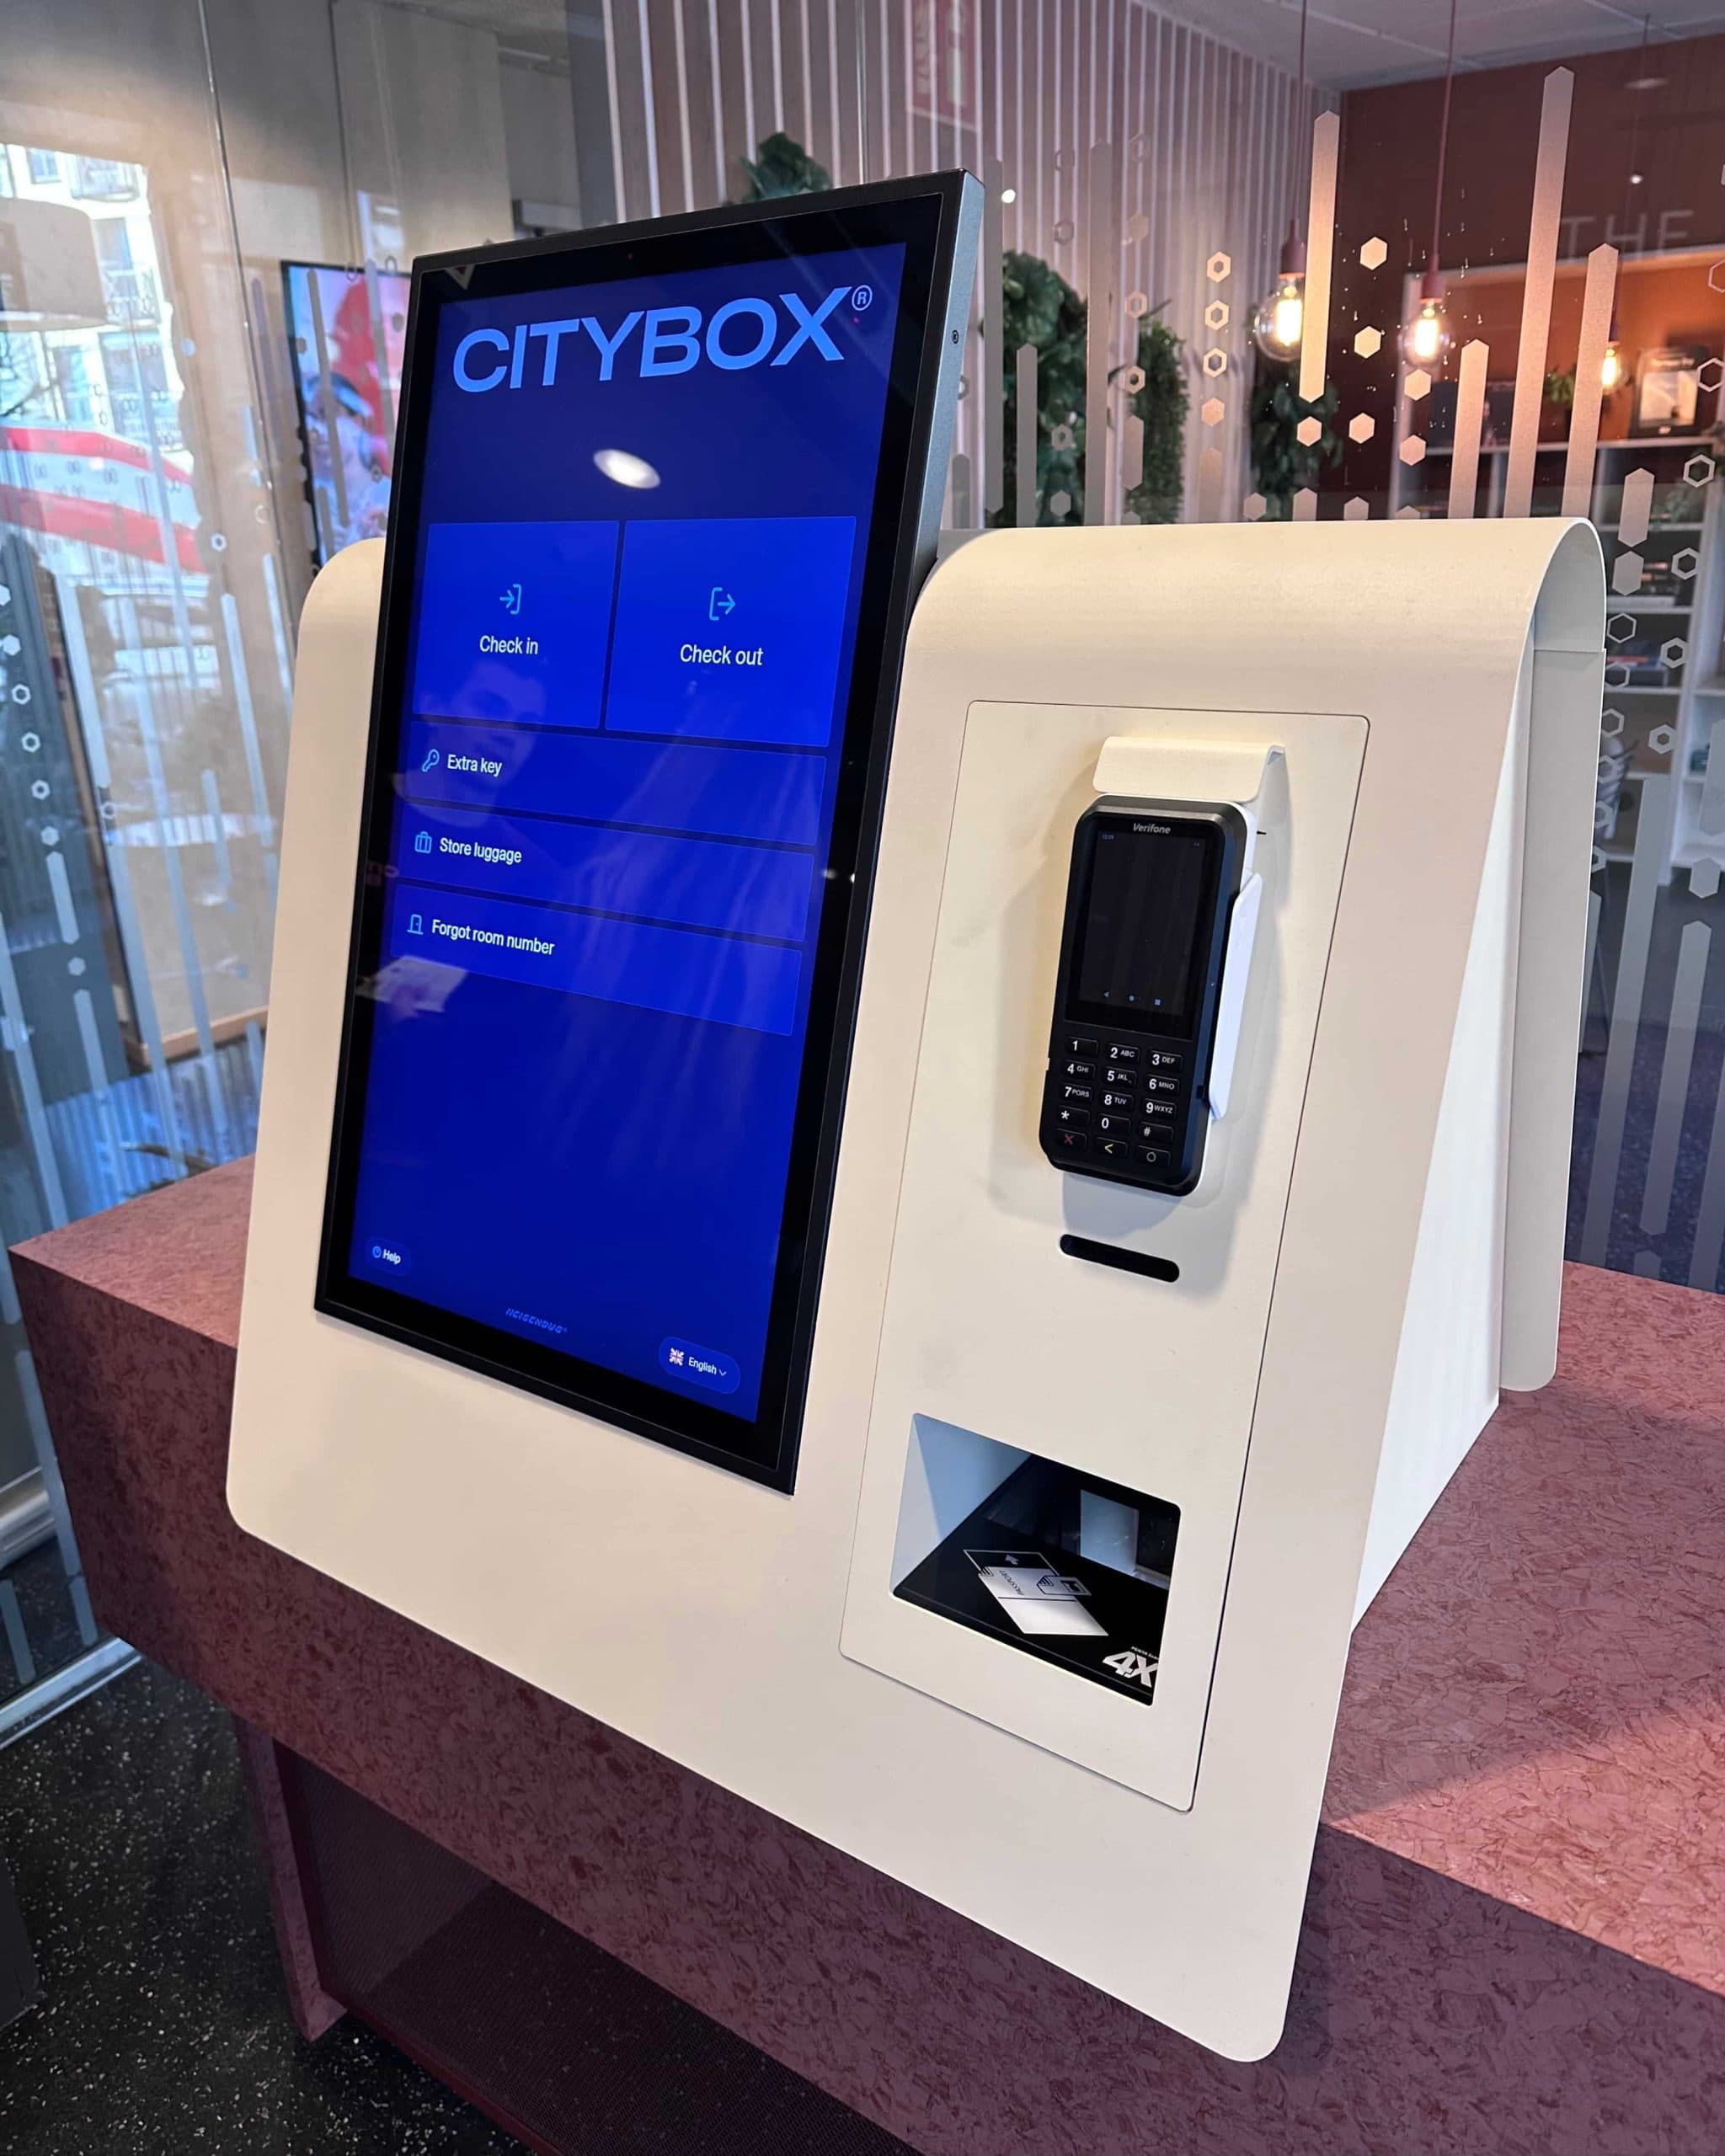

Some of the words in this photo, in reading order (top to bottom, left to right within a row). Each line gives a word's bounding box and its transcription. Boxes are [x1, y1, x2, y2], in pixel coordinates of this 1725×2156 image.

[479, 635, 523, 654] Check
[526, 637, 539, 655] in
[680, 643, 731, 664] Check
[735, 647, 764, 665] out
[447, 754, 478, 772] Extra
[480, 757, 502, 777] key
[1133, 823, 1171, 834] Verifone
[439, 837, 472, 856] Store
[473, 841, 522, 865] luggage
[431, 919, 470, 941] Forgot
[473, 927, 505, 947] room
[506, 934, 555, 955] number
[1072, 1040, 1078, 1051] 1
[1110, 1047, 1118, 1059] 2
[1151, 1054, 1160, 1065] 3
[1067, 1064, 1075, 1074] 4
[1107, 1070, 1114, 1081] 5
[1149, 1078, 1156, 1090] 6
[1158, 1081, 1175, 1090] MNO
[1065, 1086, 1072, 1097] 7
[1104, 1095, 1112, 1105] 8
[1146, 1102, 1153, 1113] 9
[1154, 1105, 1172, 1113] WXYZ
[1101, 1118, 1109, 1129] 0
[1143, 1127, 1151, 1137] #
[382, 1249, 401, 1265] Help
[688, 1356, 717, 1374] English
[1102, 1651, 1159, 1688] 4X
